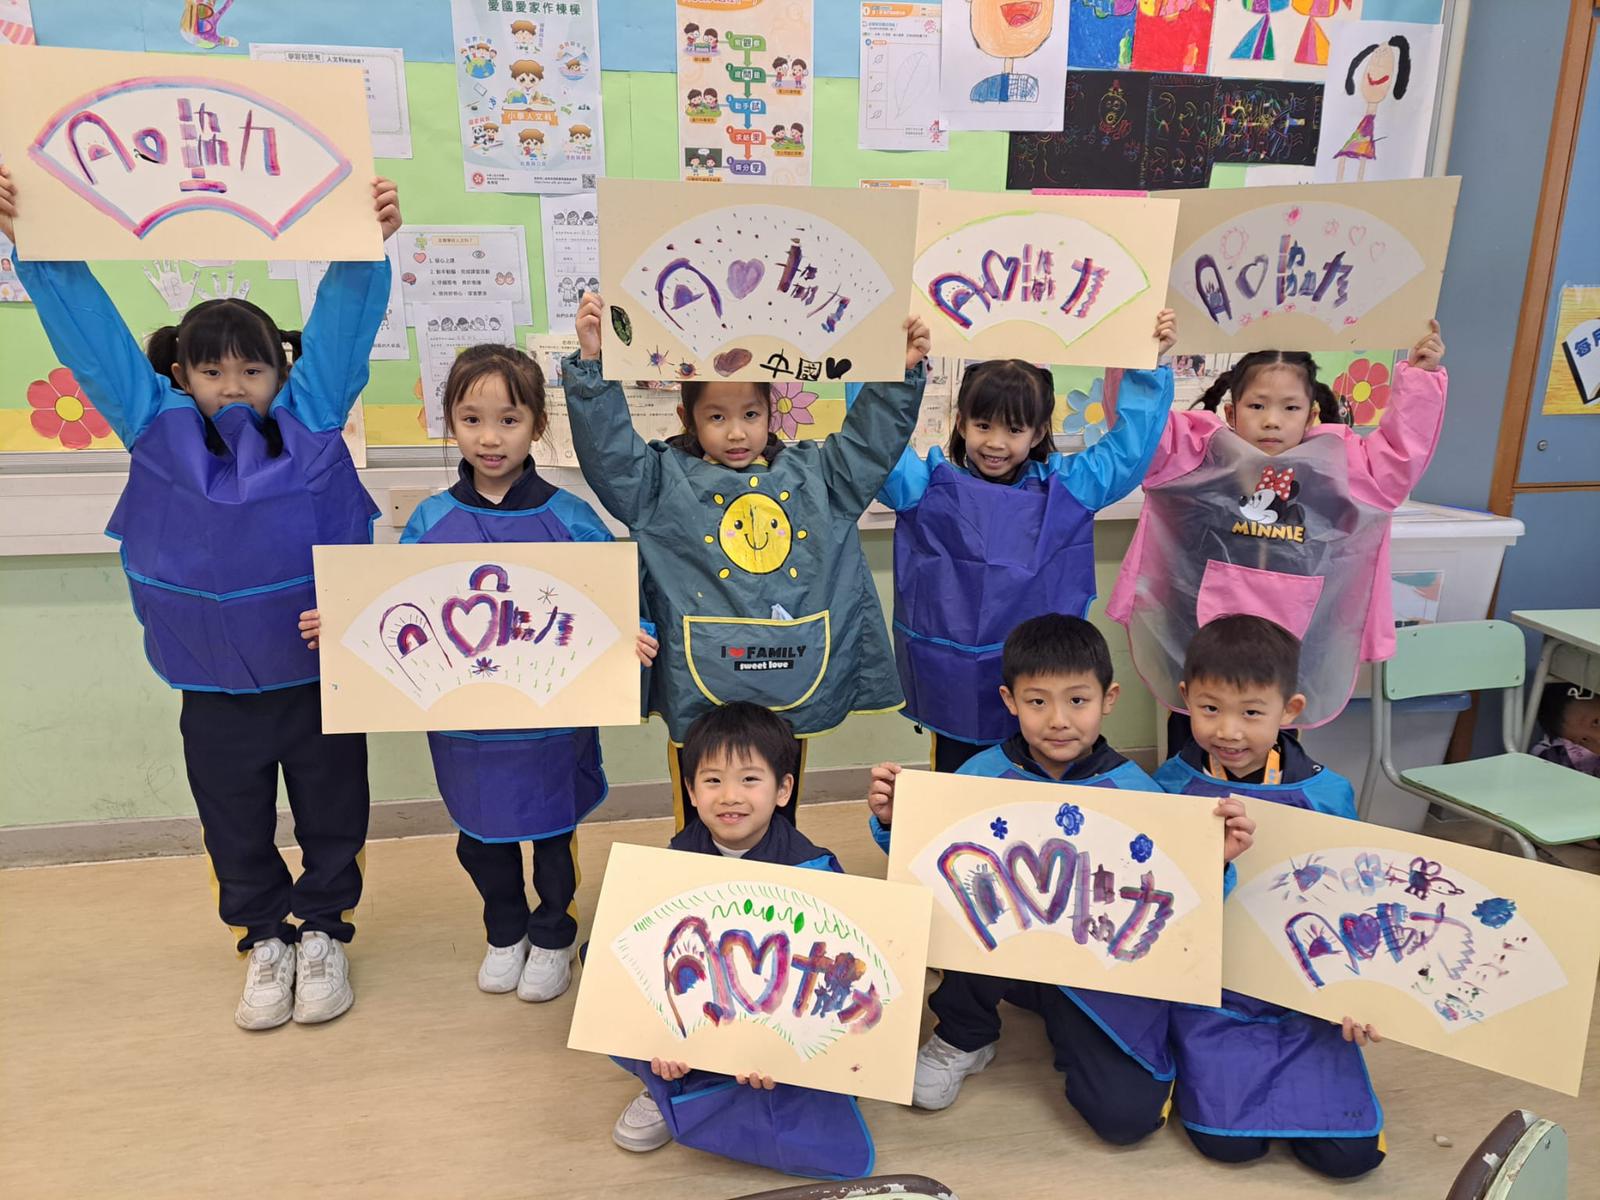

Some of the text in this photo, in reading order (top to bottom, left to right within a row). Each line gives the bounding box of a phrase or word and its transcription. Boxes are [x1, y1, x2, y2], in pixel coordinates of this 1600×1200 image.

[760, 349, 822, 381] 中國
[1231, 521, 1305, 543] MINNIE
[721, 645, 807, 659] I FAMILY
[740, 660, 789, 670] sweet love
